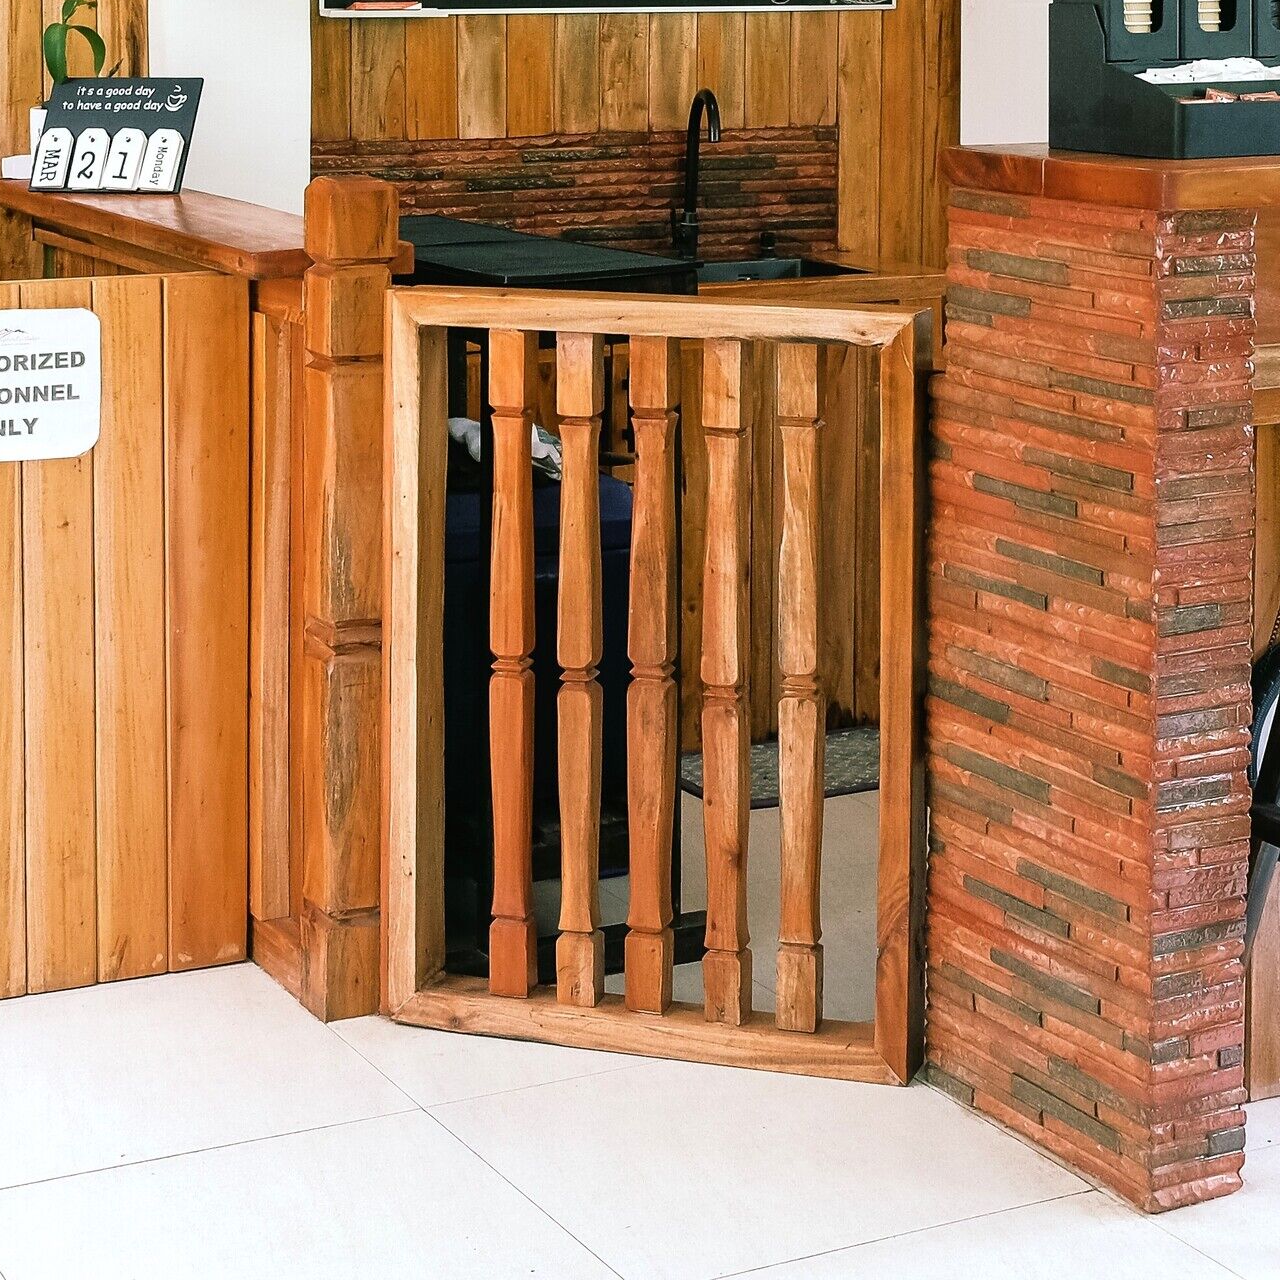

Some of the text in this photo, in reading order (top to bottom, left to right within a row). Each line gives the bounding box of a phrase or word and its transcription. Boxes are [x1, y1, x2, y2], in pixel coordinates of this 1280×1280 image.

[96, 87, 105, 96] a
[105, 85, 134, 98] good
[135, 85, 157, 98] day
[62, 100, 165, 113] to have a good day
[39, 146, 169, 186] MAR 2 1 Monday
